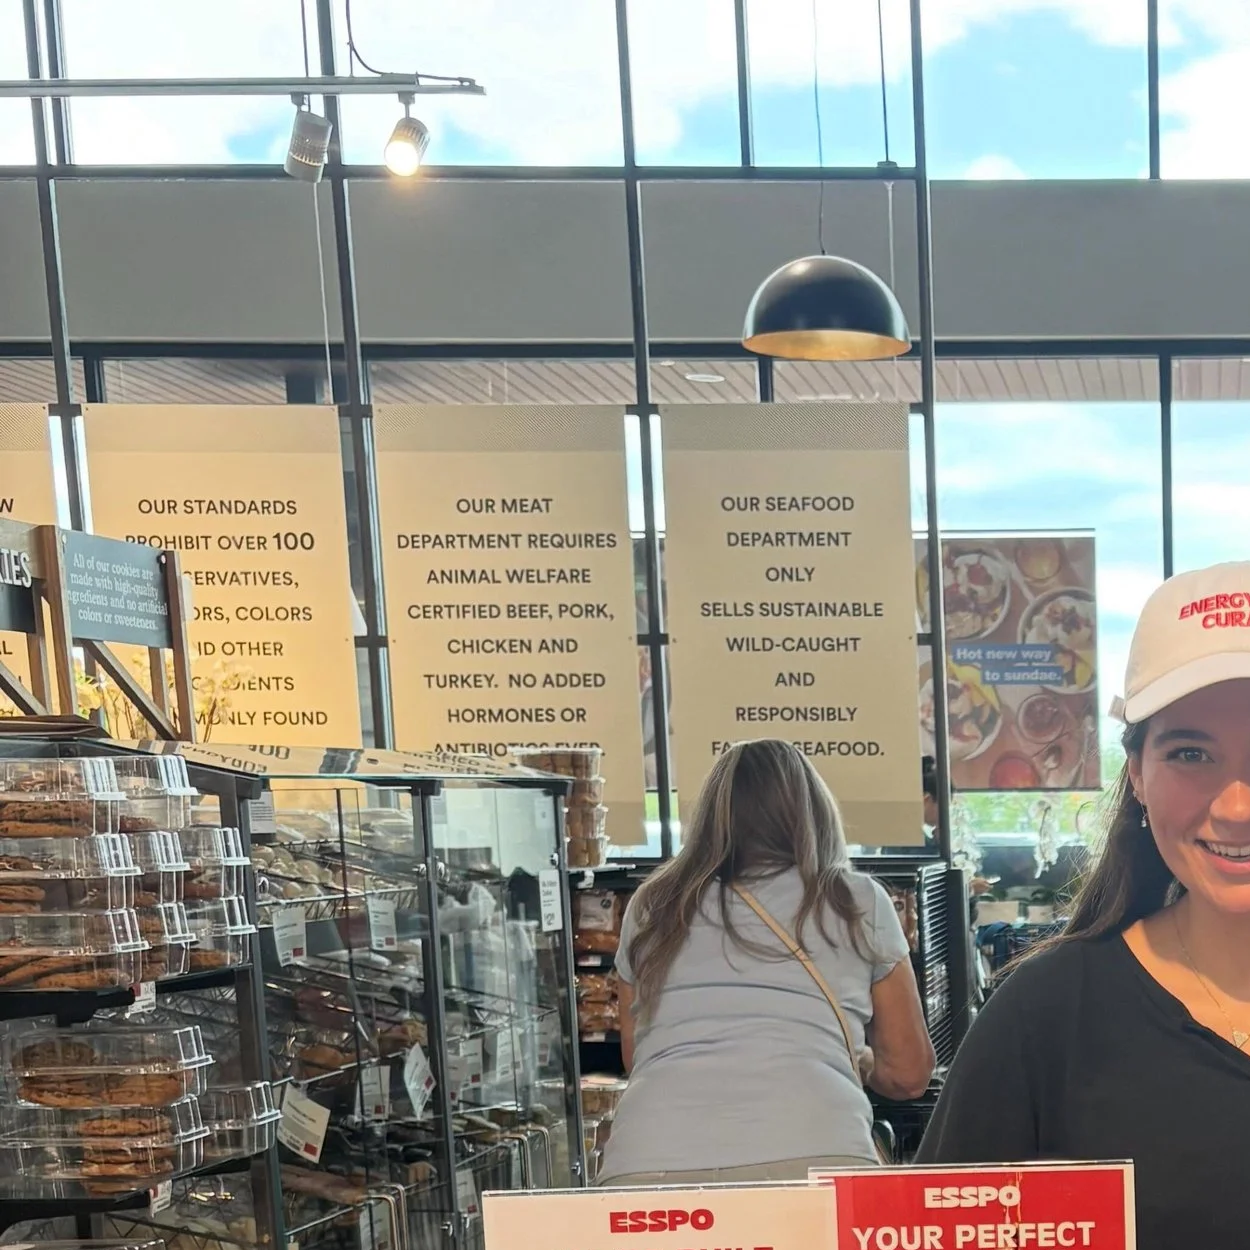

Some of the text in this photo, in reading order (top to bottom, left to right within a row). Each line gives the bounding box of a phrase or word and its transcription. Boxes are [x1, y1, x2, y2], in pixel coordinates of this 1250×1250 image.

[138, 500, 297, 515] OUR STANDARDS
[456, 498, 553, 513] OUR MEAT
[721, 496, 855, 512] OUR SEAFOOD
[217, 535, 268, 550] OVER
[273, 532, 315, 550] 100
[397, 533, 617, 549] DEPARTMENT REQUIRES
[727, 532, 852, 547] DEPARTMENT
[73, 553, 154, 581] All of our cookies are
[765, 567, 815, 582] ONLY
[183, 571, 299, 588] ERVATIVES,
[427, 569, 591, 584] ANIMAL WELFARE
[70, 572, 158, 600] made with high-quality
[67, 588, 168, 616] ngredients and no artificial
[700, 602, 883, 617] SELLS SUSTAINABLE
[78, 608, 159, 630] colors or sweeteners.
[235, 607, 313, 621] COLORS
[407, 603, 614, 622] CERTIFIED BEEF, PORK,
[222, 641, 284, 656] OTHER
[447, 638, 578, 654] CHICKEN AND
[726, 637, 861, 653] WILD-CAUGHT
[956, 648, 1052, 663] Hot new way
[423, 673, 606, 689] TURKEY. NO ADDED
[775, 672, 815, 687] AND
[985, 669, 1062, 682] to sundae.
[263, 711, 328, 726] FOUND
[447, 708, 587, 723] HORMONES OR
[735, 707, 858, 722] RESPONSIBLY
[796, 741, 885, 756] SEAFOOD.
[924, 1185, 1021, 1209] ESSPO
[609, 1208, 714, 1234] ESSPO
[955, 1221, 1095, 1249] PERFECT
